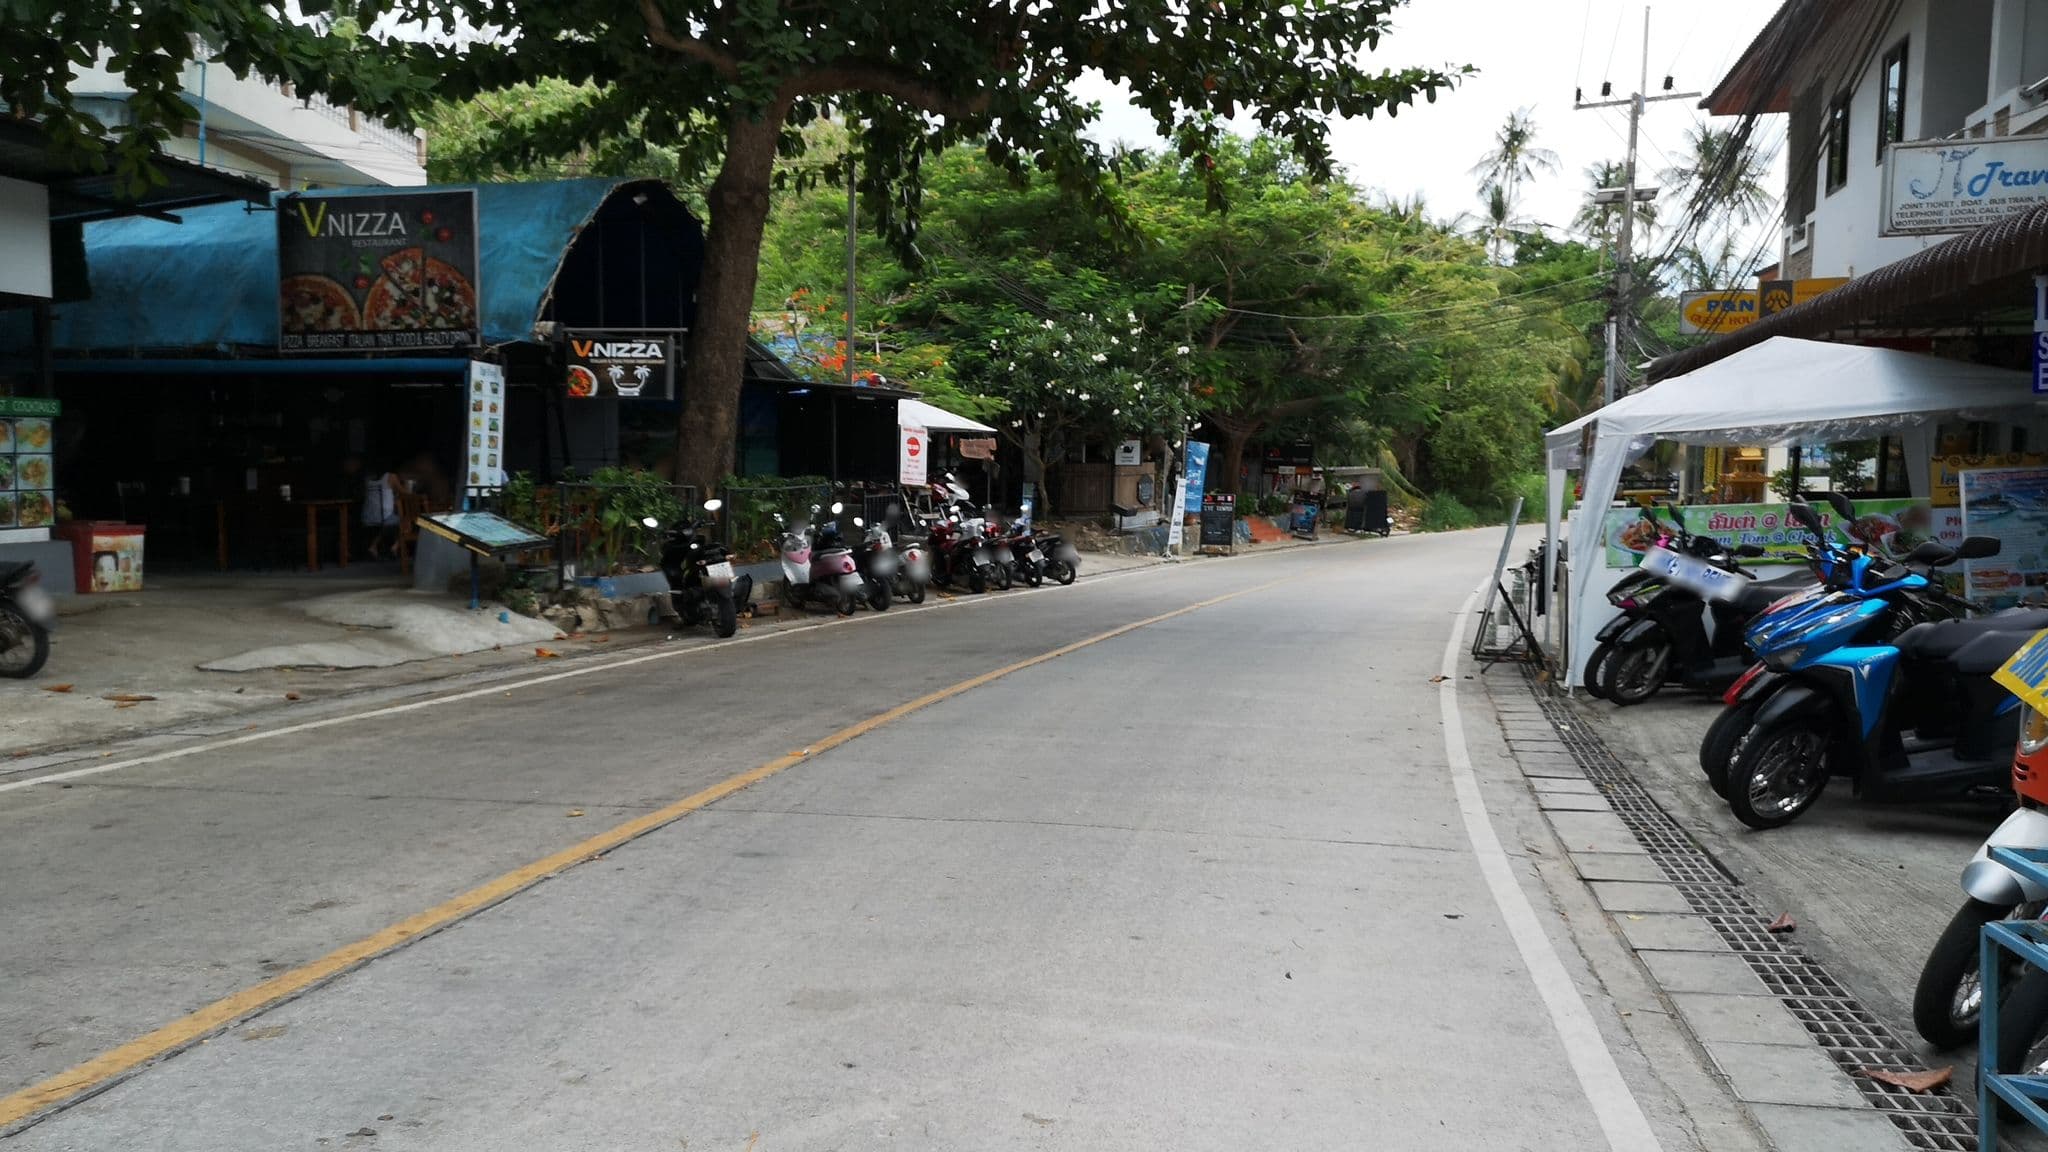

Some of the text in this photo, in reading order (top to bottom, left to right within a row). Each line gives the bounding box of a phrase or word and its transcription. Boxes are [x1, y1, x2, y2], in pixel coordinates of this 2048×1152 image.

[1900, 201, 1923, 210] JOINT
[1926, 200, 1954, 209] TICKET
[1960, 199, 1982, 207] BOAT
[1989, 197, 2006, 205] BUS
[1896, 210, 1944, 218] TELEPHONE
[1950, 208, 1976, 216] LOCAL
[1979, 206, 2000, 215] CALL
[299, 201, 407, 237] V.NIZZA
[1895, 218, 1943, 227] MOTORBIKE
[1949, 216, 1984, 224] BICYCLE
[352, 238, 407, 248] RESTAURANT
[1728, 315, 1755, 325] HOU
[571, 340, 663, 358] V.NIZZA
[1761, 512, 1778, 529] @
